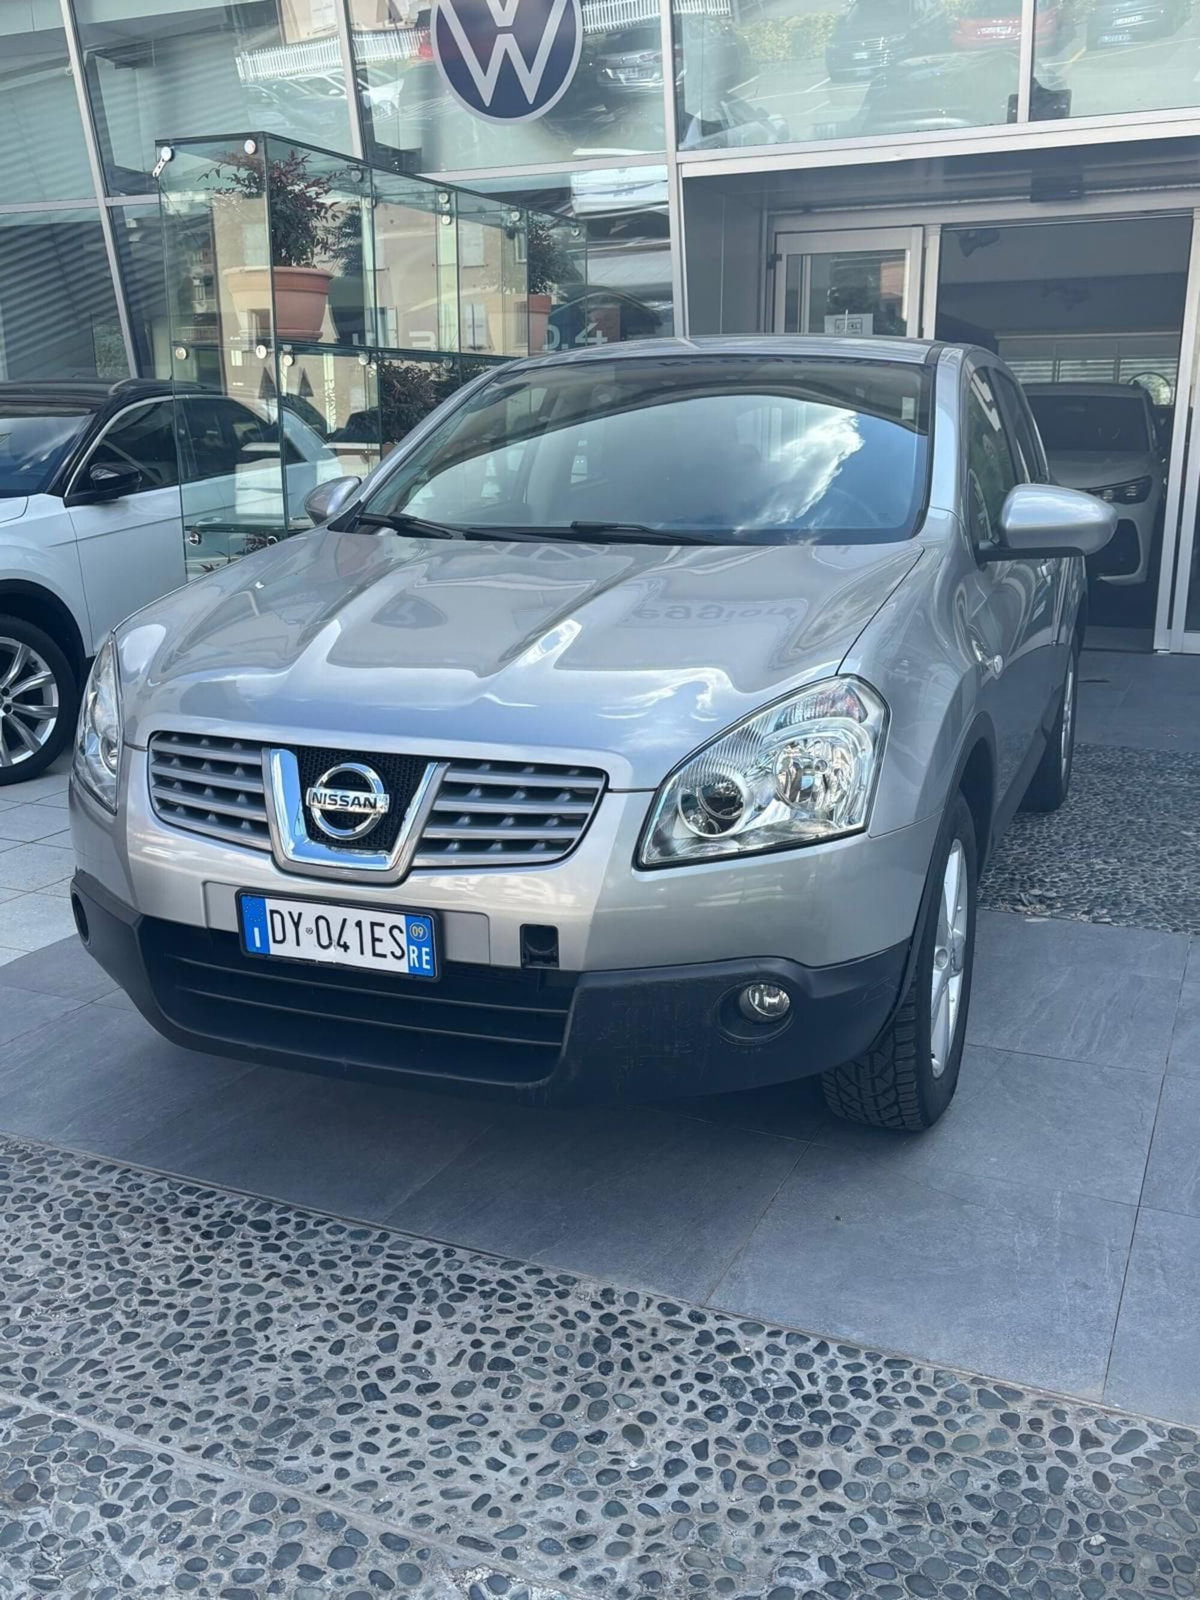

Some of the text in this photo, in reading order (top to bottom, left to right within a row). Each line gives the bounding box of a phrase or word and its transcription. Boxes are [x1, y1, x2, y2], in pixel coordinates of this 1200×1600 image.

[311, 791, 377, 810] NISSAN
[269, 909, 302, 947] DY
[409, 944, 431, 969] RE
